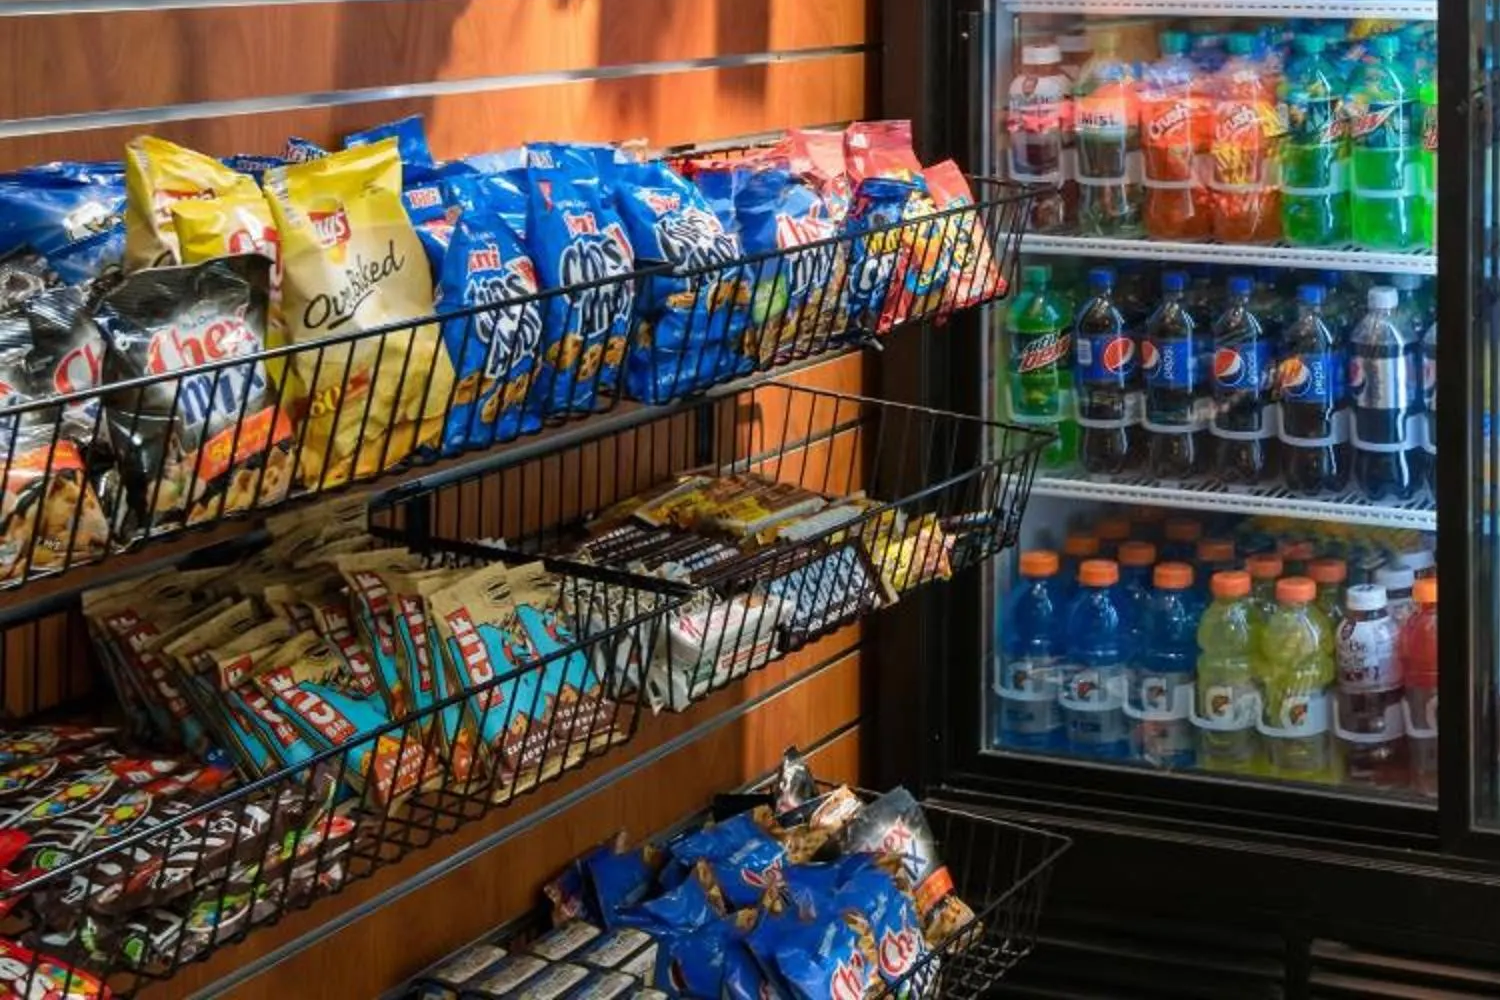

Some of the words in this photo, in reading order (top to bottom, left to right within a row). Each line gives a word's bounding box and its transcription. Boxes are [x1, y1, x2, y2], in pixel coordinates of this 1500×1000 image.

[1150, 101, 1190, 140] Crush
[450, 616, 494, 687] CLIF
[269, 673, 336, 725] CLIF
